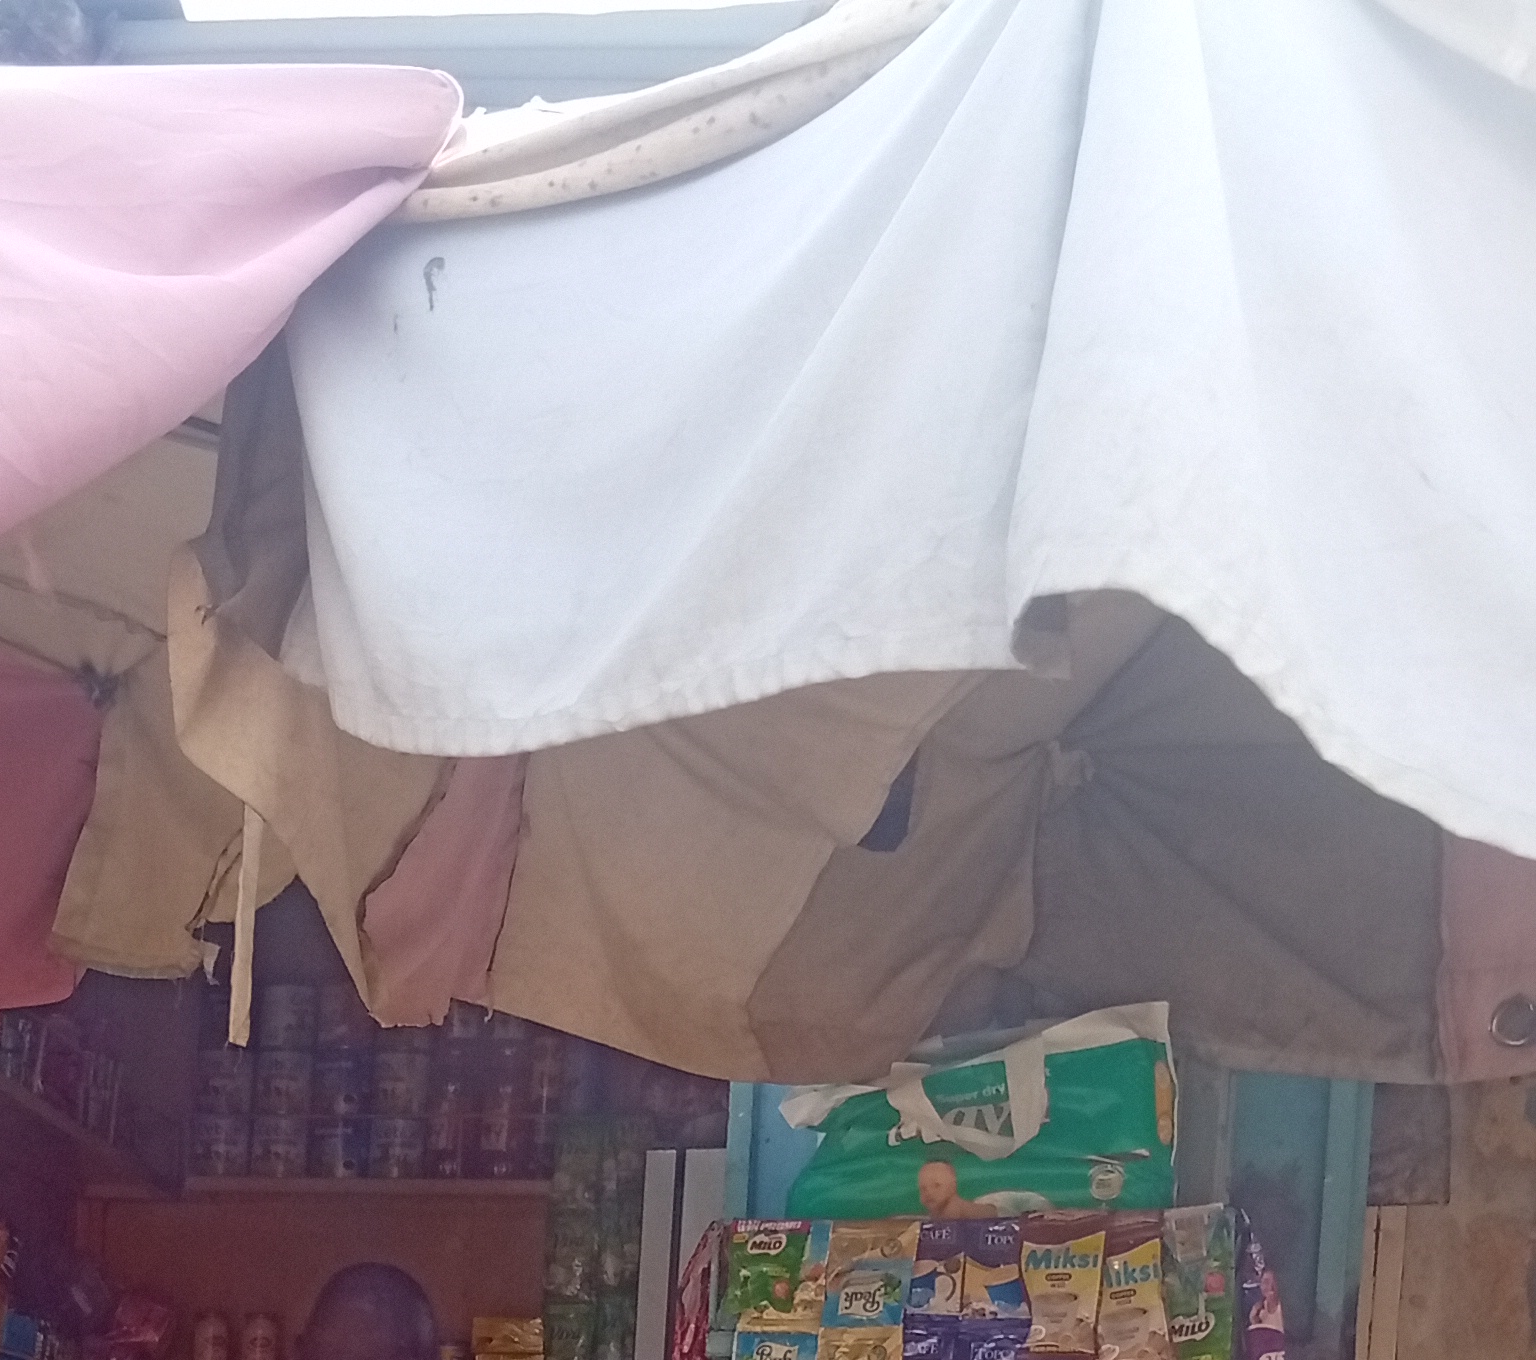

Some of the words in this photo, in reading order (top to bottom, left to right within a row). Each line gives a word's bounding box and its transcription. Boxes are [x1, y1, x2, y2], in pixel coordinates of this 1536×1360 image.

[750, 1239, 782, 1251] MILO
[1025, 1248, 1098, 1271] Miksi
[1171, 1320, 1210, 1338] MILO
